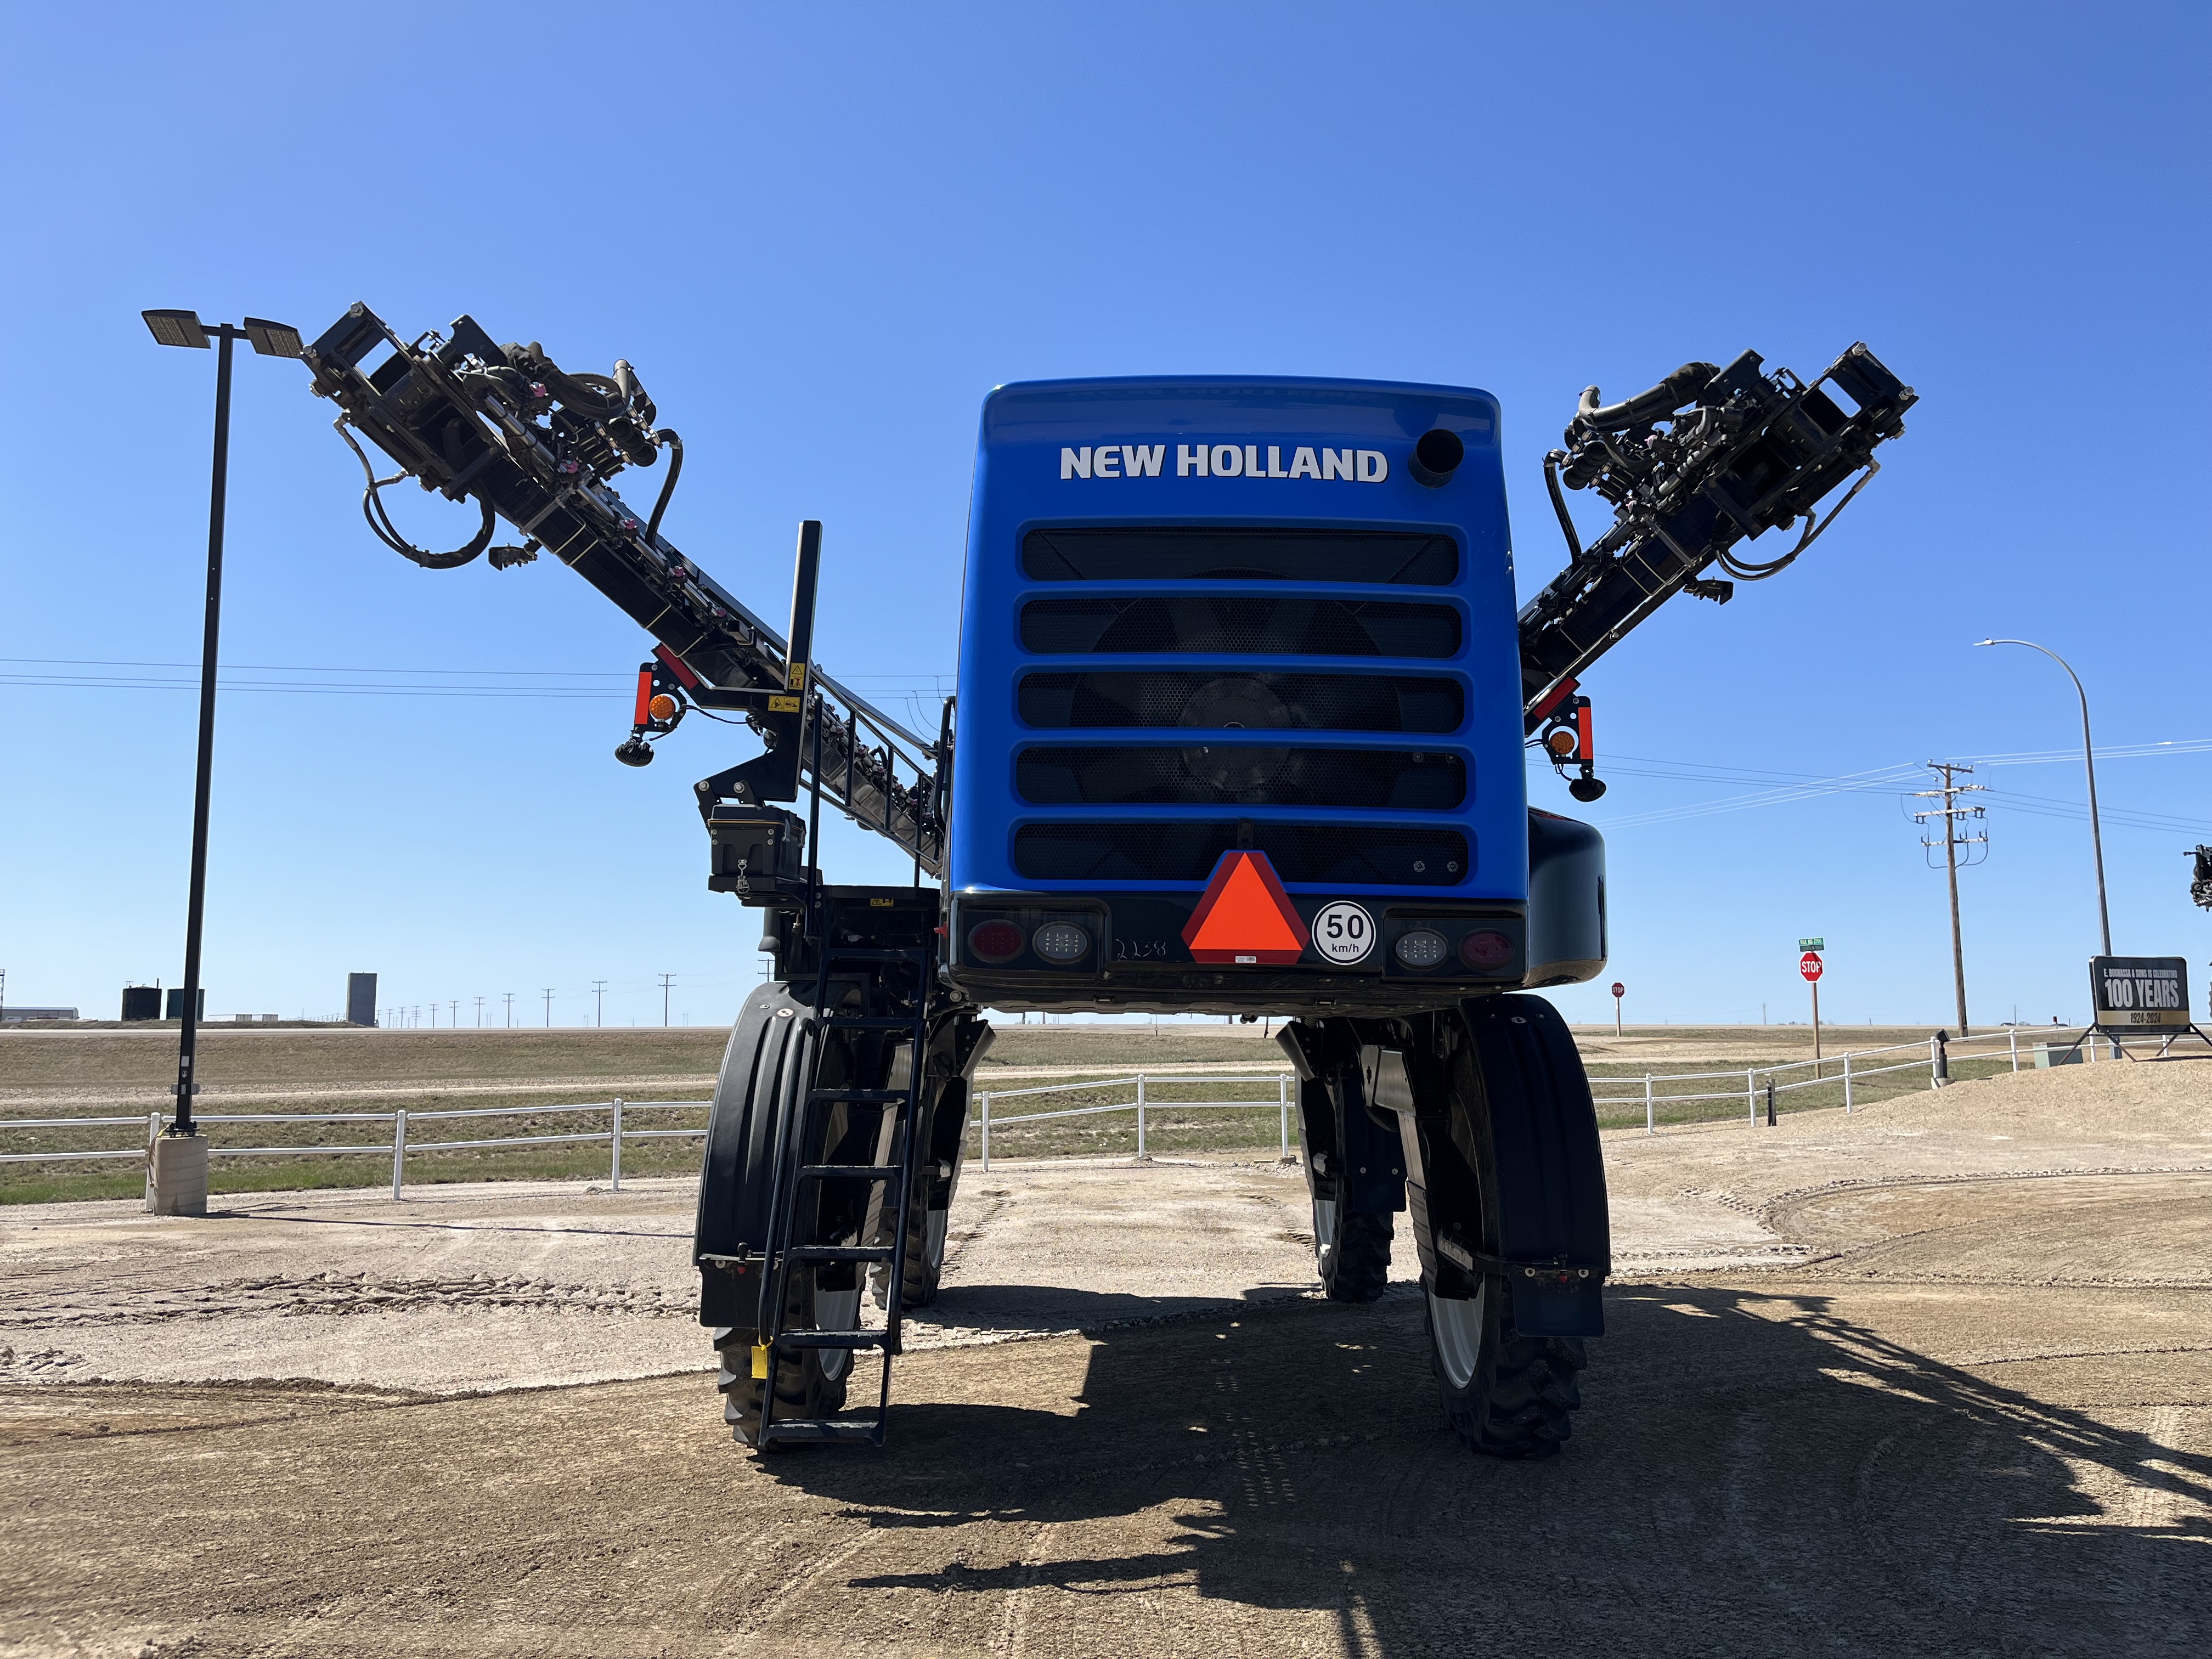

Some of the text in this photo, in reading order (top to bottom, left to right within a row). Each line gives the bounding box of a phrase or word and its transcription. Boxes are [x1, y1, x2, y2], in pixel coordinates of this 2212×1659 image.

[1060, 444, 1389, 483] NEW HOLLAND
[1327, 914, 1364, 939] 50
[1332, 943, 1359, 952] km/h
[1802, 961, 1821, 973] STOP
[2104, 979, 2180, 1008] 100 YEARS
[2130, 1012, 2161, 1024] 1924-2024
